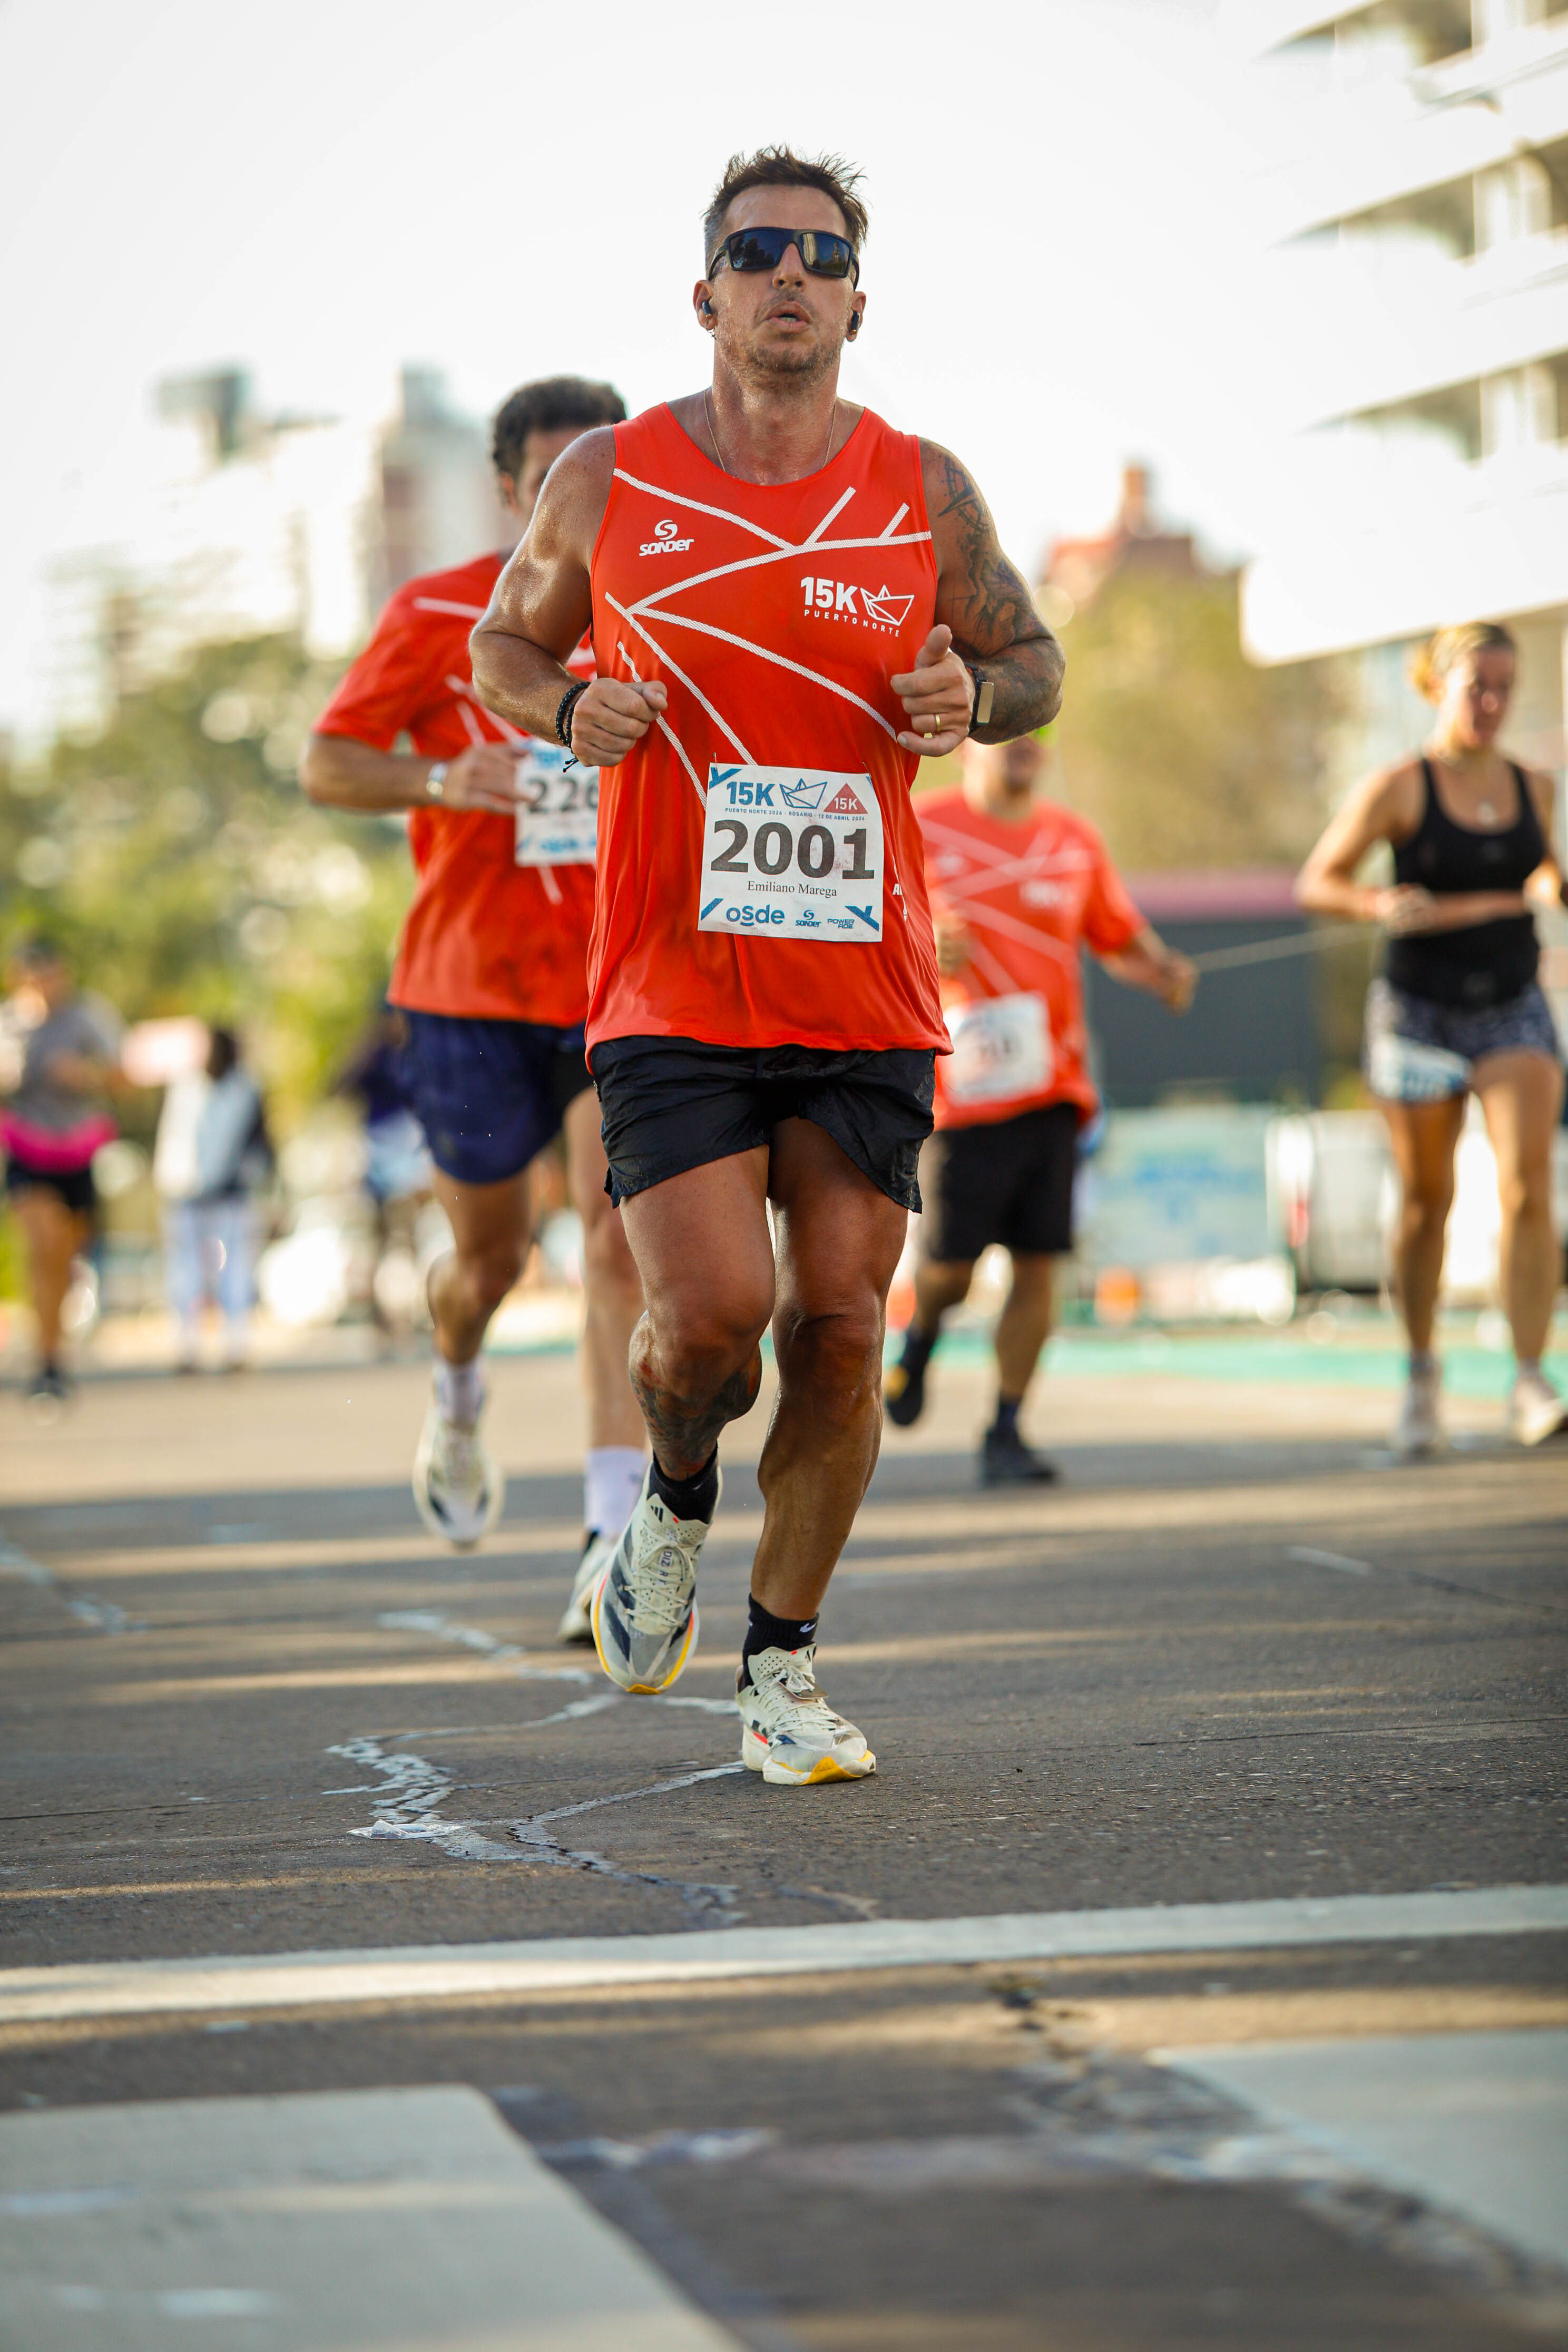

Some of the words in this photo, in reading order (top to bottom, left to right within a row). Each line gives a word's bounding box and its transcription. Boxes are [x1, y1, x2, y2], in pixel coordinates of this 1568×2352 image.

[800, 576, 858, 614] 15K
[804, 609, 858, 624] PUERTO
[863, 620, 900, 637] NORTE
[726, 781, 776, 807] 15K
[834, 798, 858, 810] 15K
[711, 820, 875, 879] 2001
[747, 880, 795, 893] Emiliano
[798, 884, 837, 898] Marega
[726, 904, 785, 924] osde
